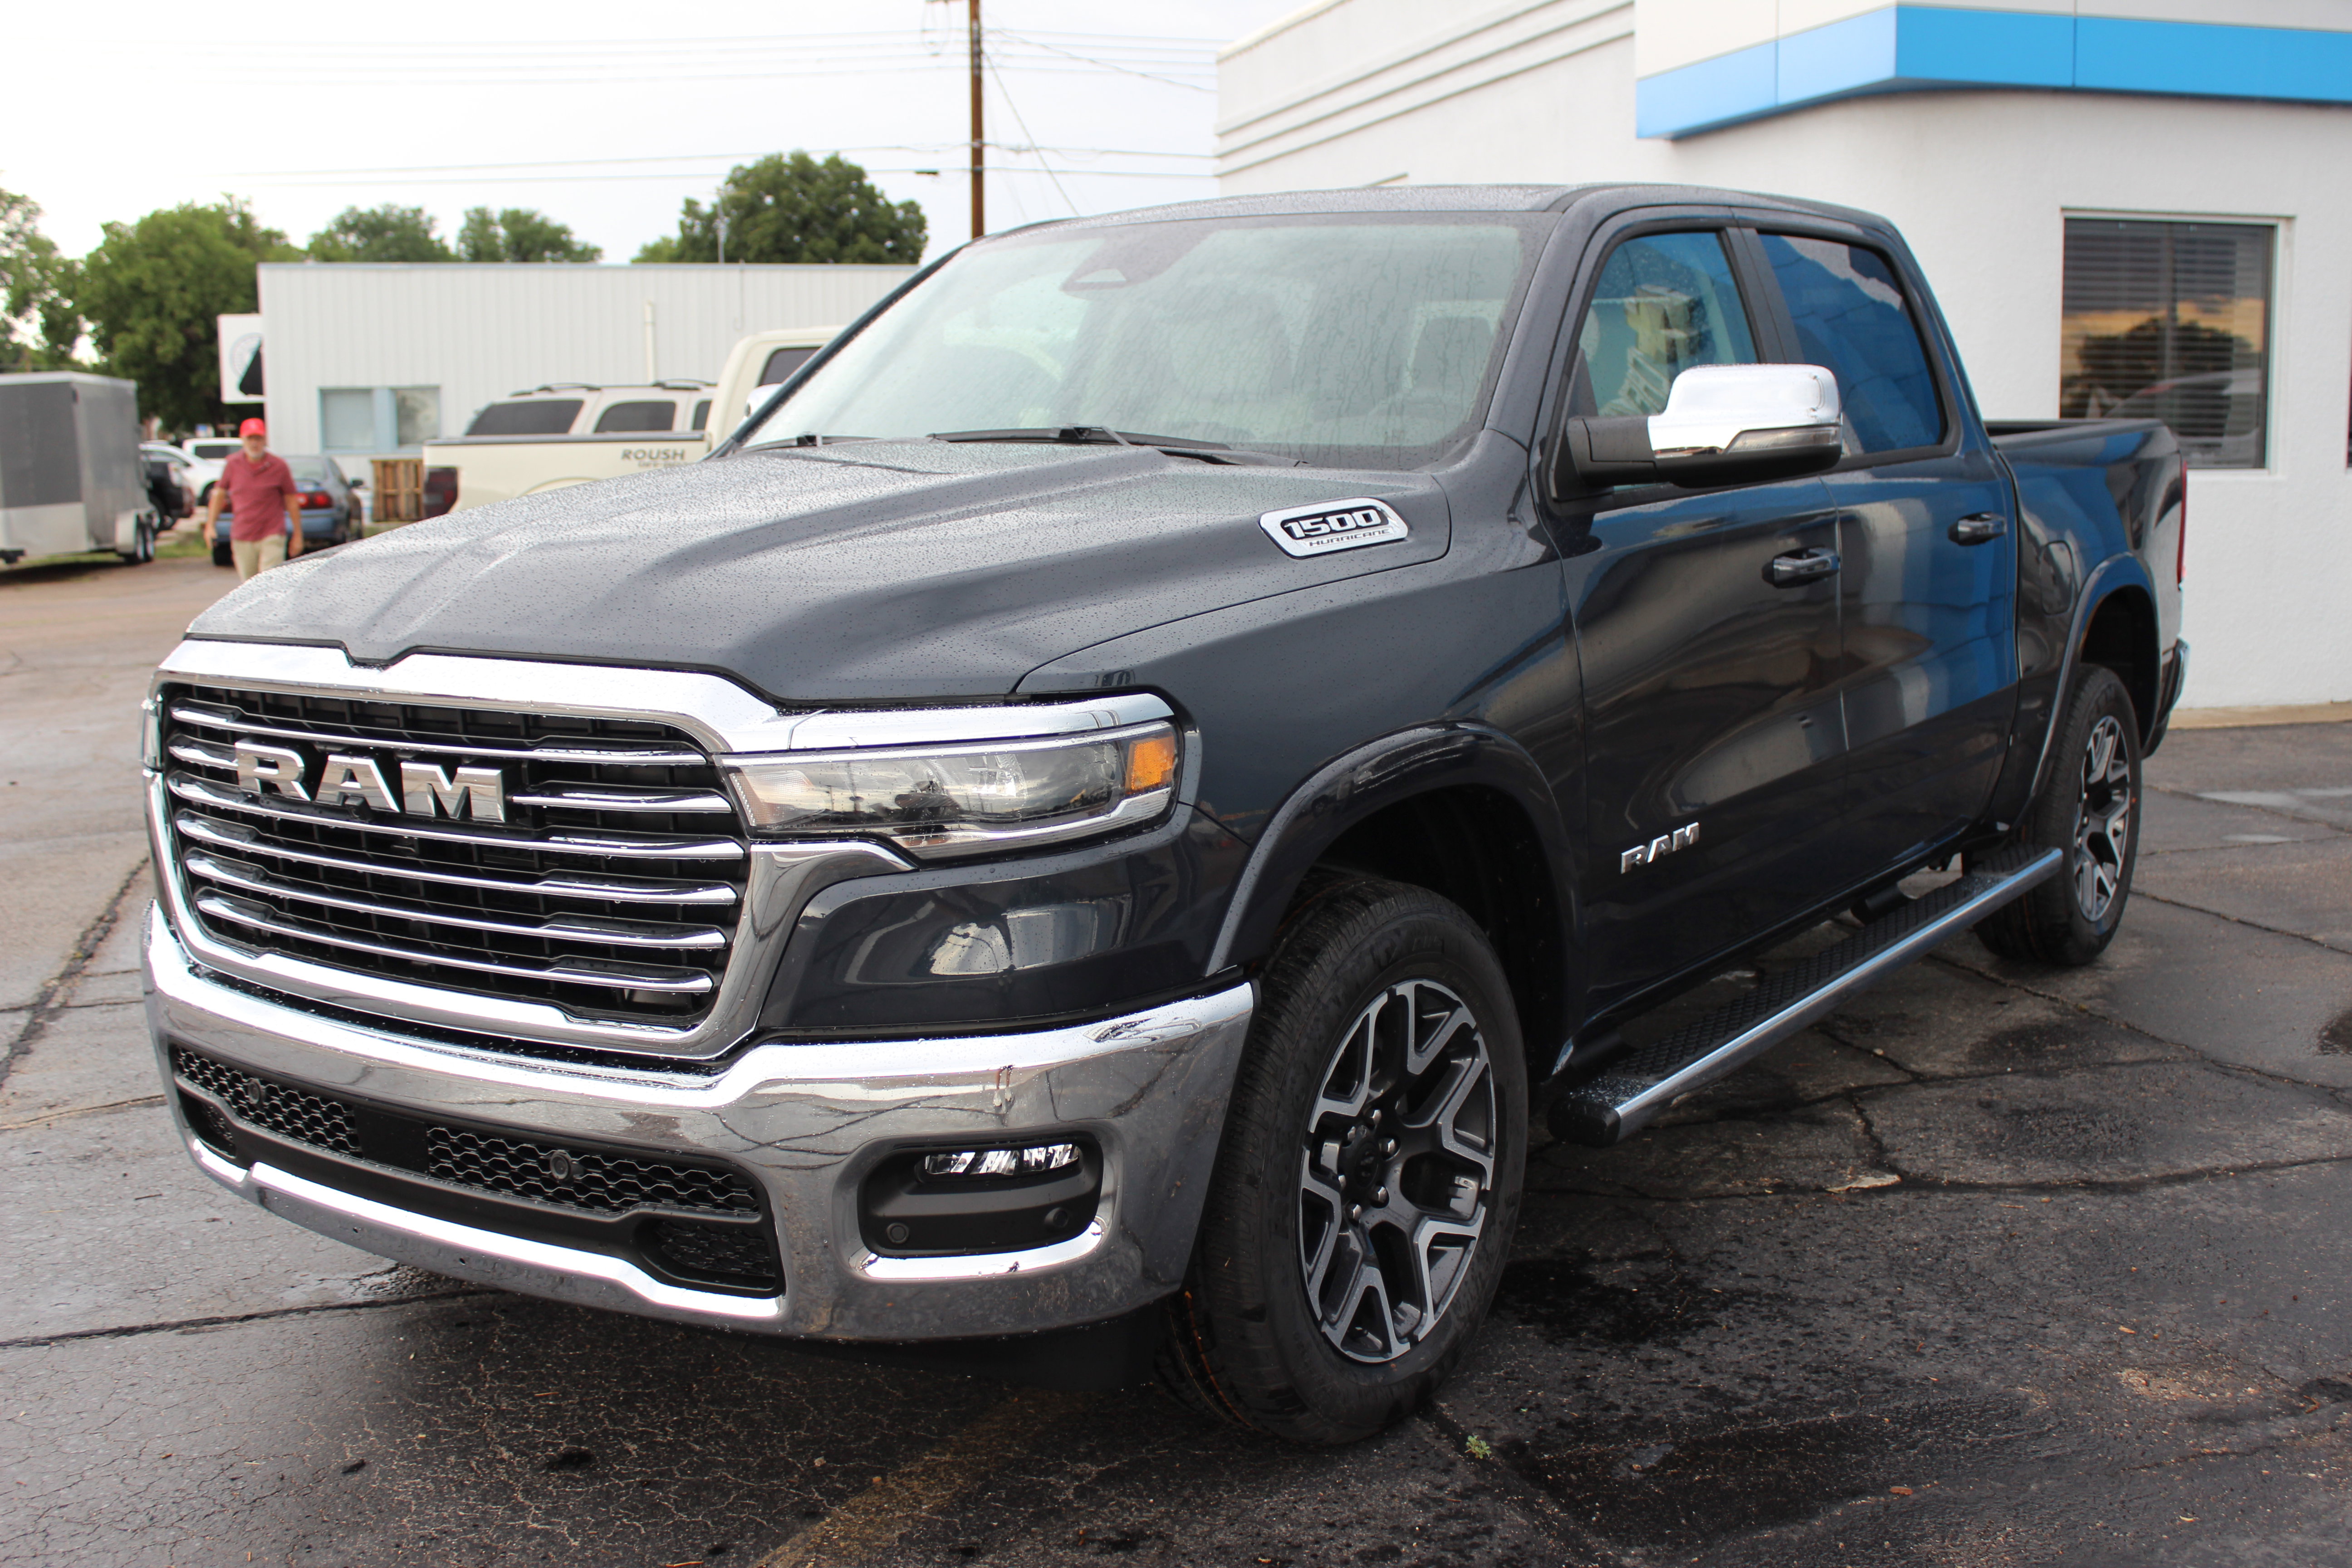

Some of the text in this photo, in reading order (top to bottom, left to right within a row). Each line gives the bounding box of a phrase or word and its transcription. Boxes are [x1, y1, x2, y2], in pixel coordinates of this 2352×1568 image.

[621, 449, 685, 460] ROUSH
[1285, 509, 1382, 538] 1500
[1309, 529, 1391, 547] HURRICANE
[235, 741, 506, 822] RAM
[1620, 822, 1700, 874] RAM
